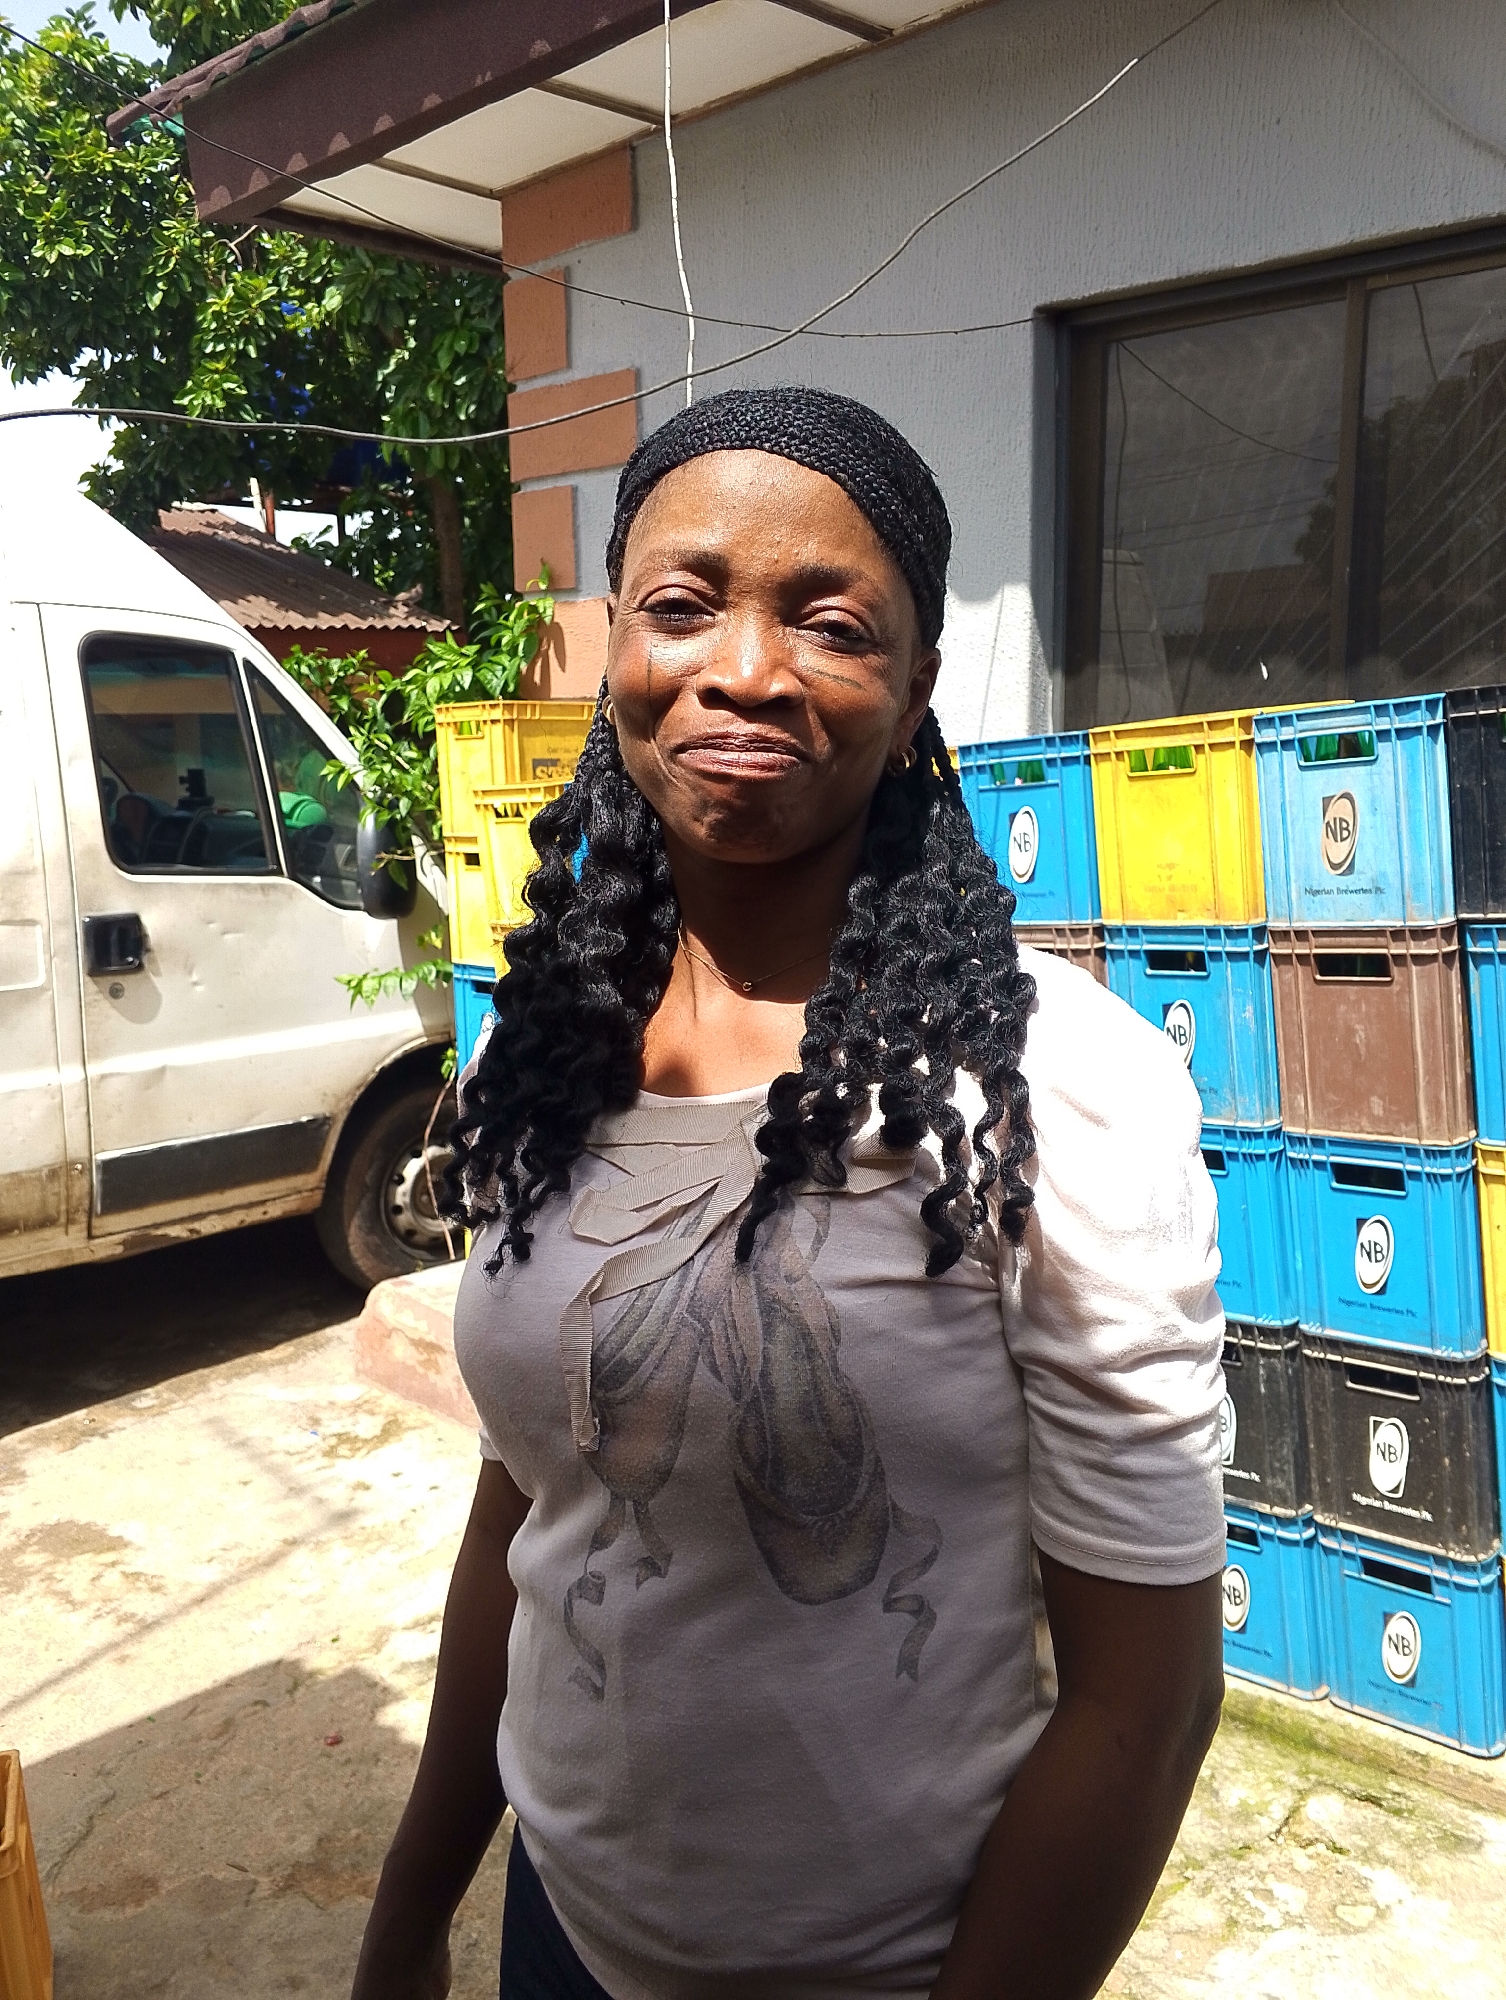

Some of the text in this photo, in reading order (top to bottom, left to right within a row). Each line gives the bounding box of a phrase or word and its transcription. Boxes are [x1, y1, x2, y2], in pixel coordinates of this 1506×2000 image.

[1325, 816, 1351, 843] NB
[1012, 831, 1032, 853] NB
[1304, 887, 1335, 897] Nigerian
[1336, 886, 1372, 895] Breweries
[1166, 1024, 1188, 1046] NB
[1360, 1239, 1385, 1263] NB
[1376, 1442, 1398, 1463] NB
[1351, 1491, 1383, 1508] Nigerian
[1383, 1499, 1421, 1519] Breweries
[1222, 1584, 1243, 1607] NB
[1387, 1632, 1413, 1657] NB
